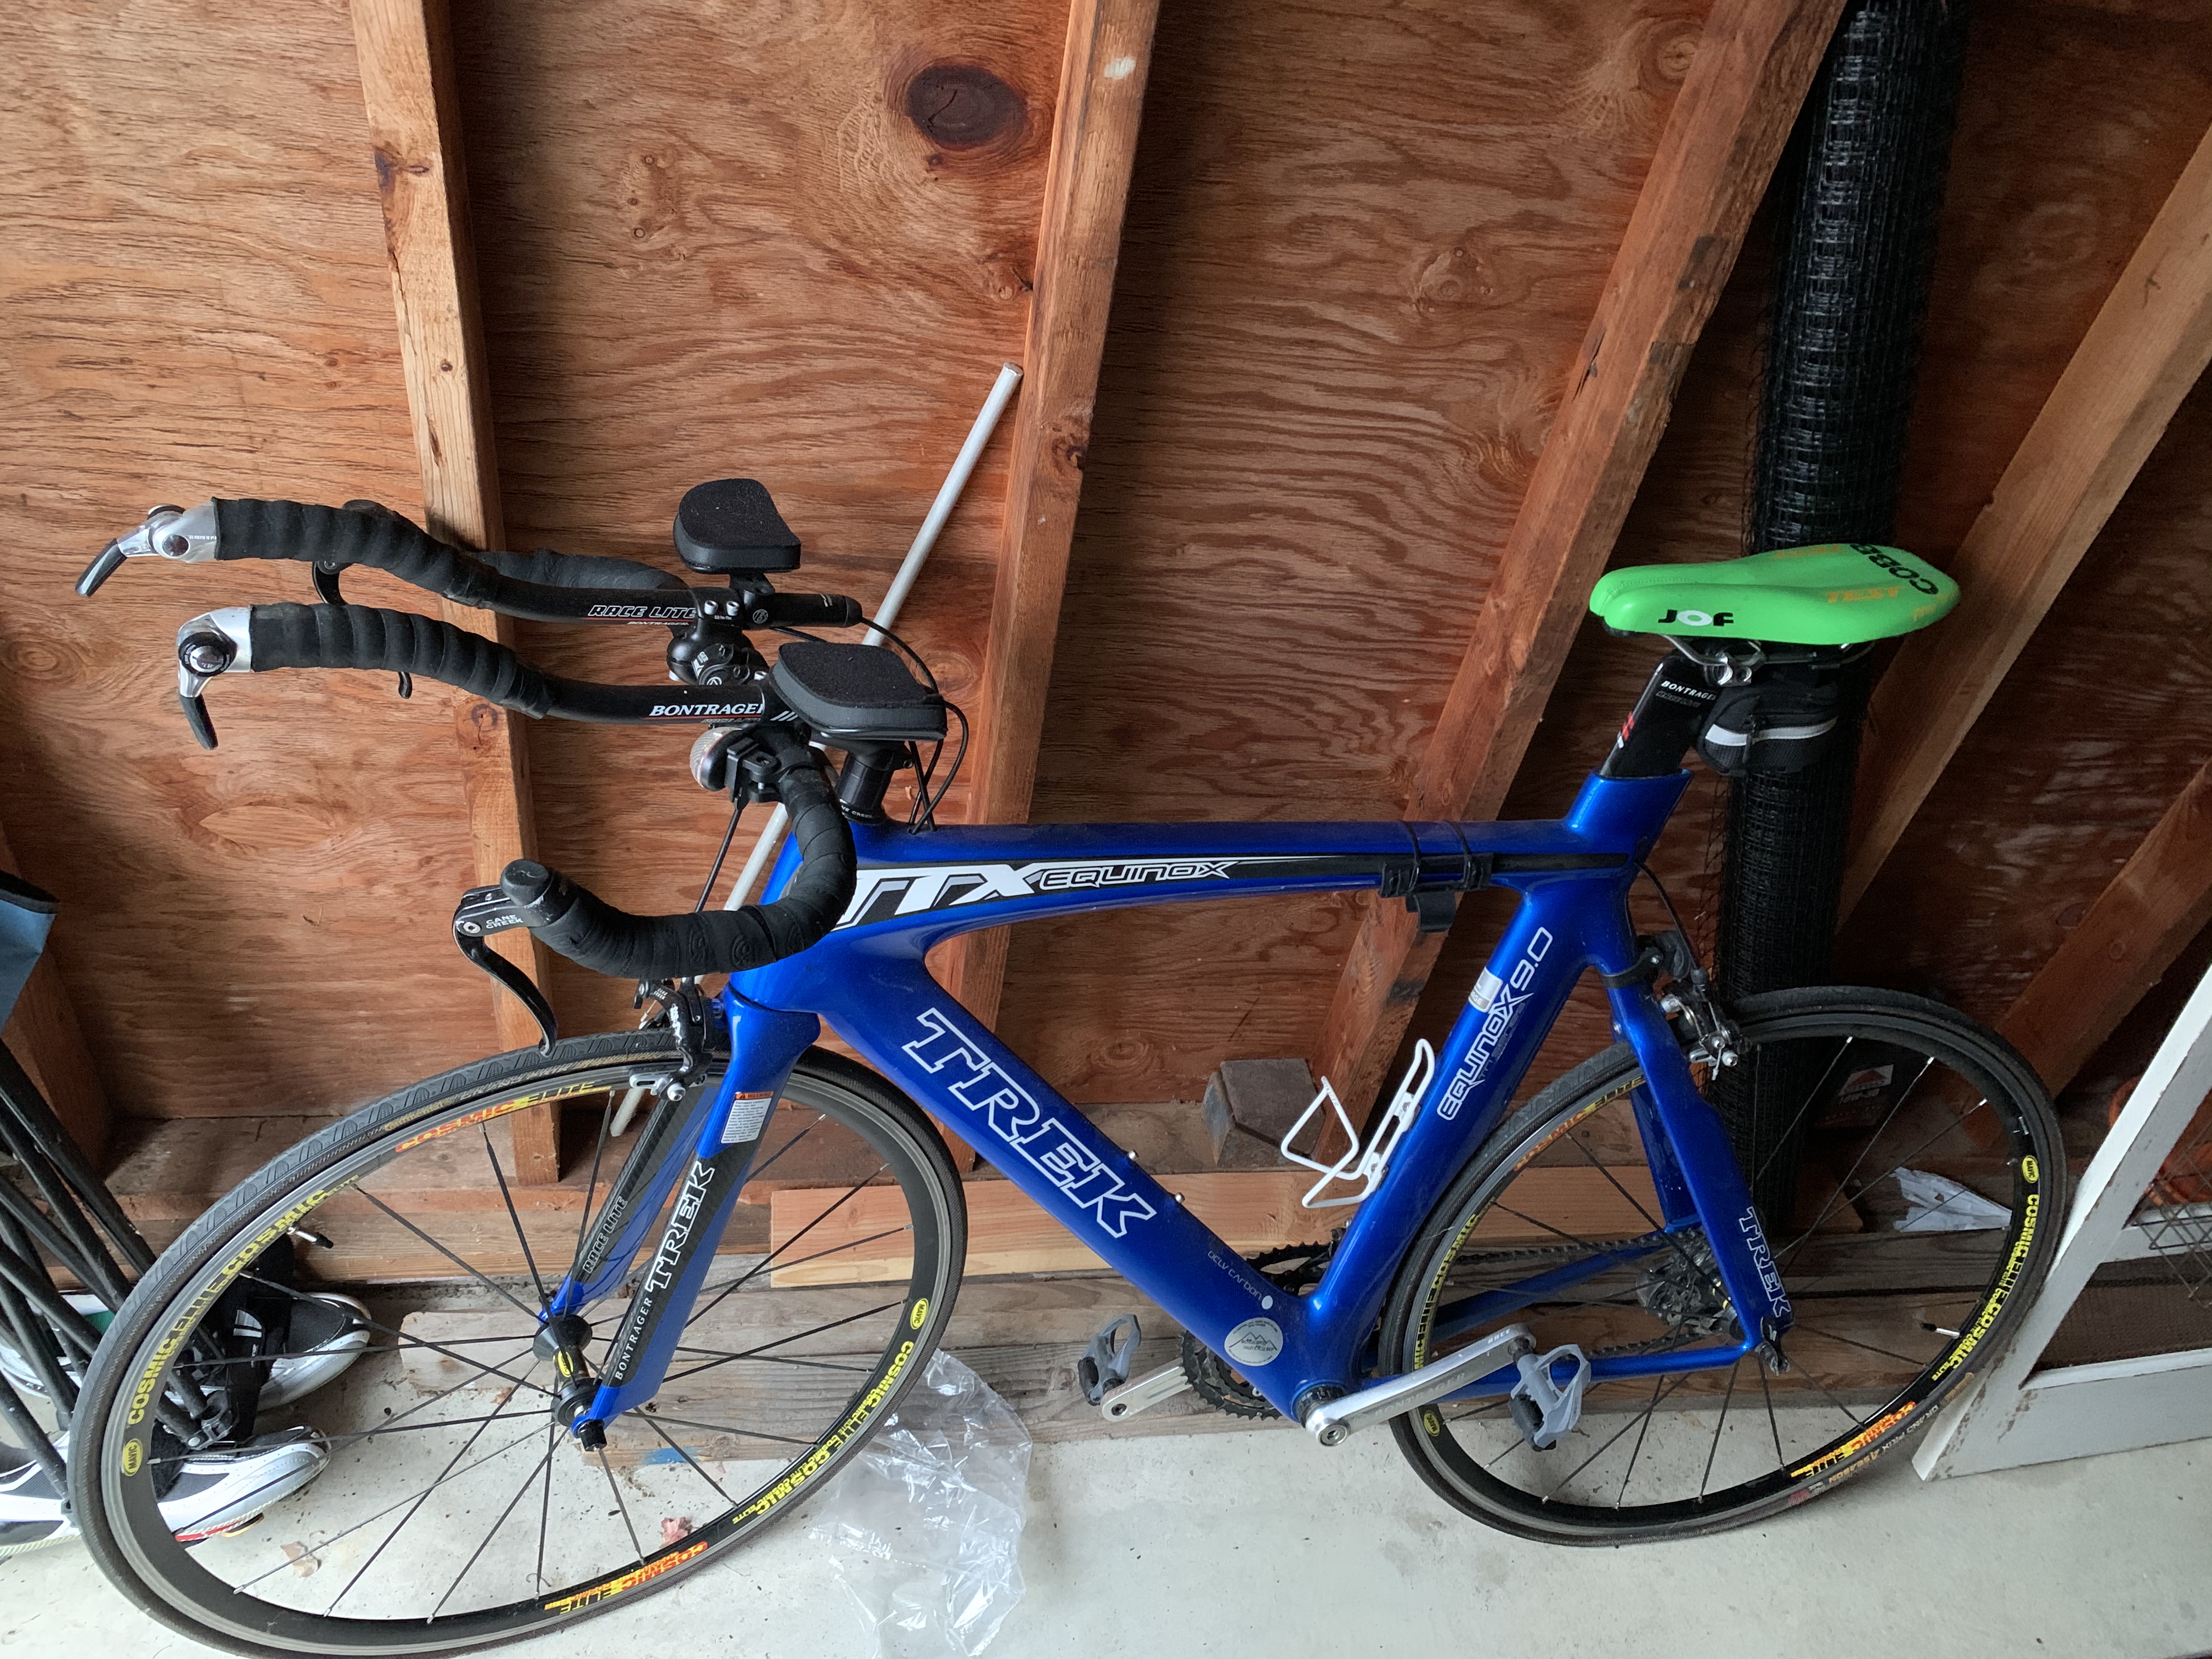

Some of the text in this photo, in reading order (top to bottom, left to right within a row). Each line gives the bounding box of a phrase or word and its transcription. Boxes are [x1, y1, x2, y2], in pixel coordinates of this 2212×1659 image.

[588, 605, 697, 619] RACE LITE
[1039, 860, 1239, 890] EQUINOX
[486, 914, 517, 924] CANE
[486, 918, 524, 929] CREEK
[1437, 984, 1535, 1120] EQUINOX
[395, 1099, 517, 1152] COSMIC
[527, 1081, 596, 1104] ELITE
[902, 1007, 1157, 1239] TREK
[2027, 1160, 2036, 1178] MAVIC
[222, 1189, 327, 1276] COSMIC
[583, 1197, 628, 1273] RACE LITE
[644, 1161, 715, 1293] TREK
[2017, 1194, 2040, 1257] COSMIC
[1207, 1250, 1229, 1270] OCLV
[1739, 1206, 1792, 1318] TREK
[172, 1279, 225, 1332] ELITE
[913, 1304, 925, 1324] MAVIC
[1487, 1328, 1511, 1344] RACE
[1950, 1303, 2002, 1369] COSMIC
[615, 1297, 653, 1381] BONTRAGER
[128, 1338, 180, 1425] COSMIC
[756, 1341, 914, 1515] COSMIC ELITE COSMIC
[1427, 1414, 1437, 1432] MAVIC
[1805, 1401, 1916, 1478] COSMIC ELITE
[1882, 1432, 1905, 1452] PRIX
[1906, 1404, 1939, 1432] GRAND
[128, 1445, 137, 1470] MAVIC
[560, 1541, 708, 1615] COSMIC ELITE
